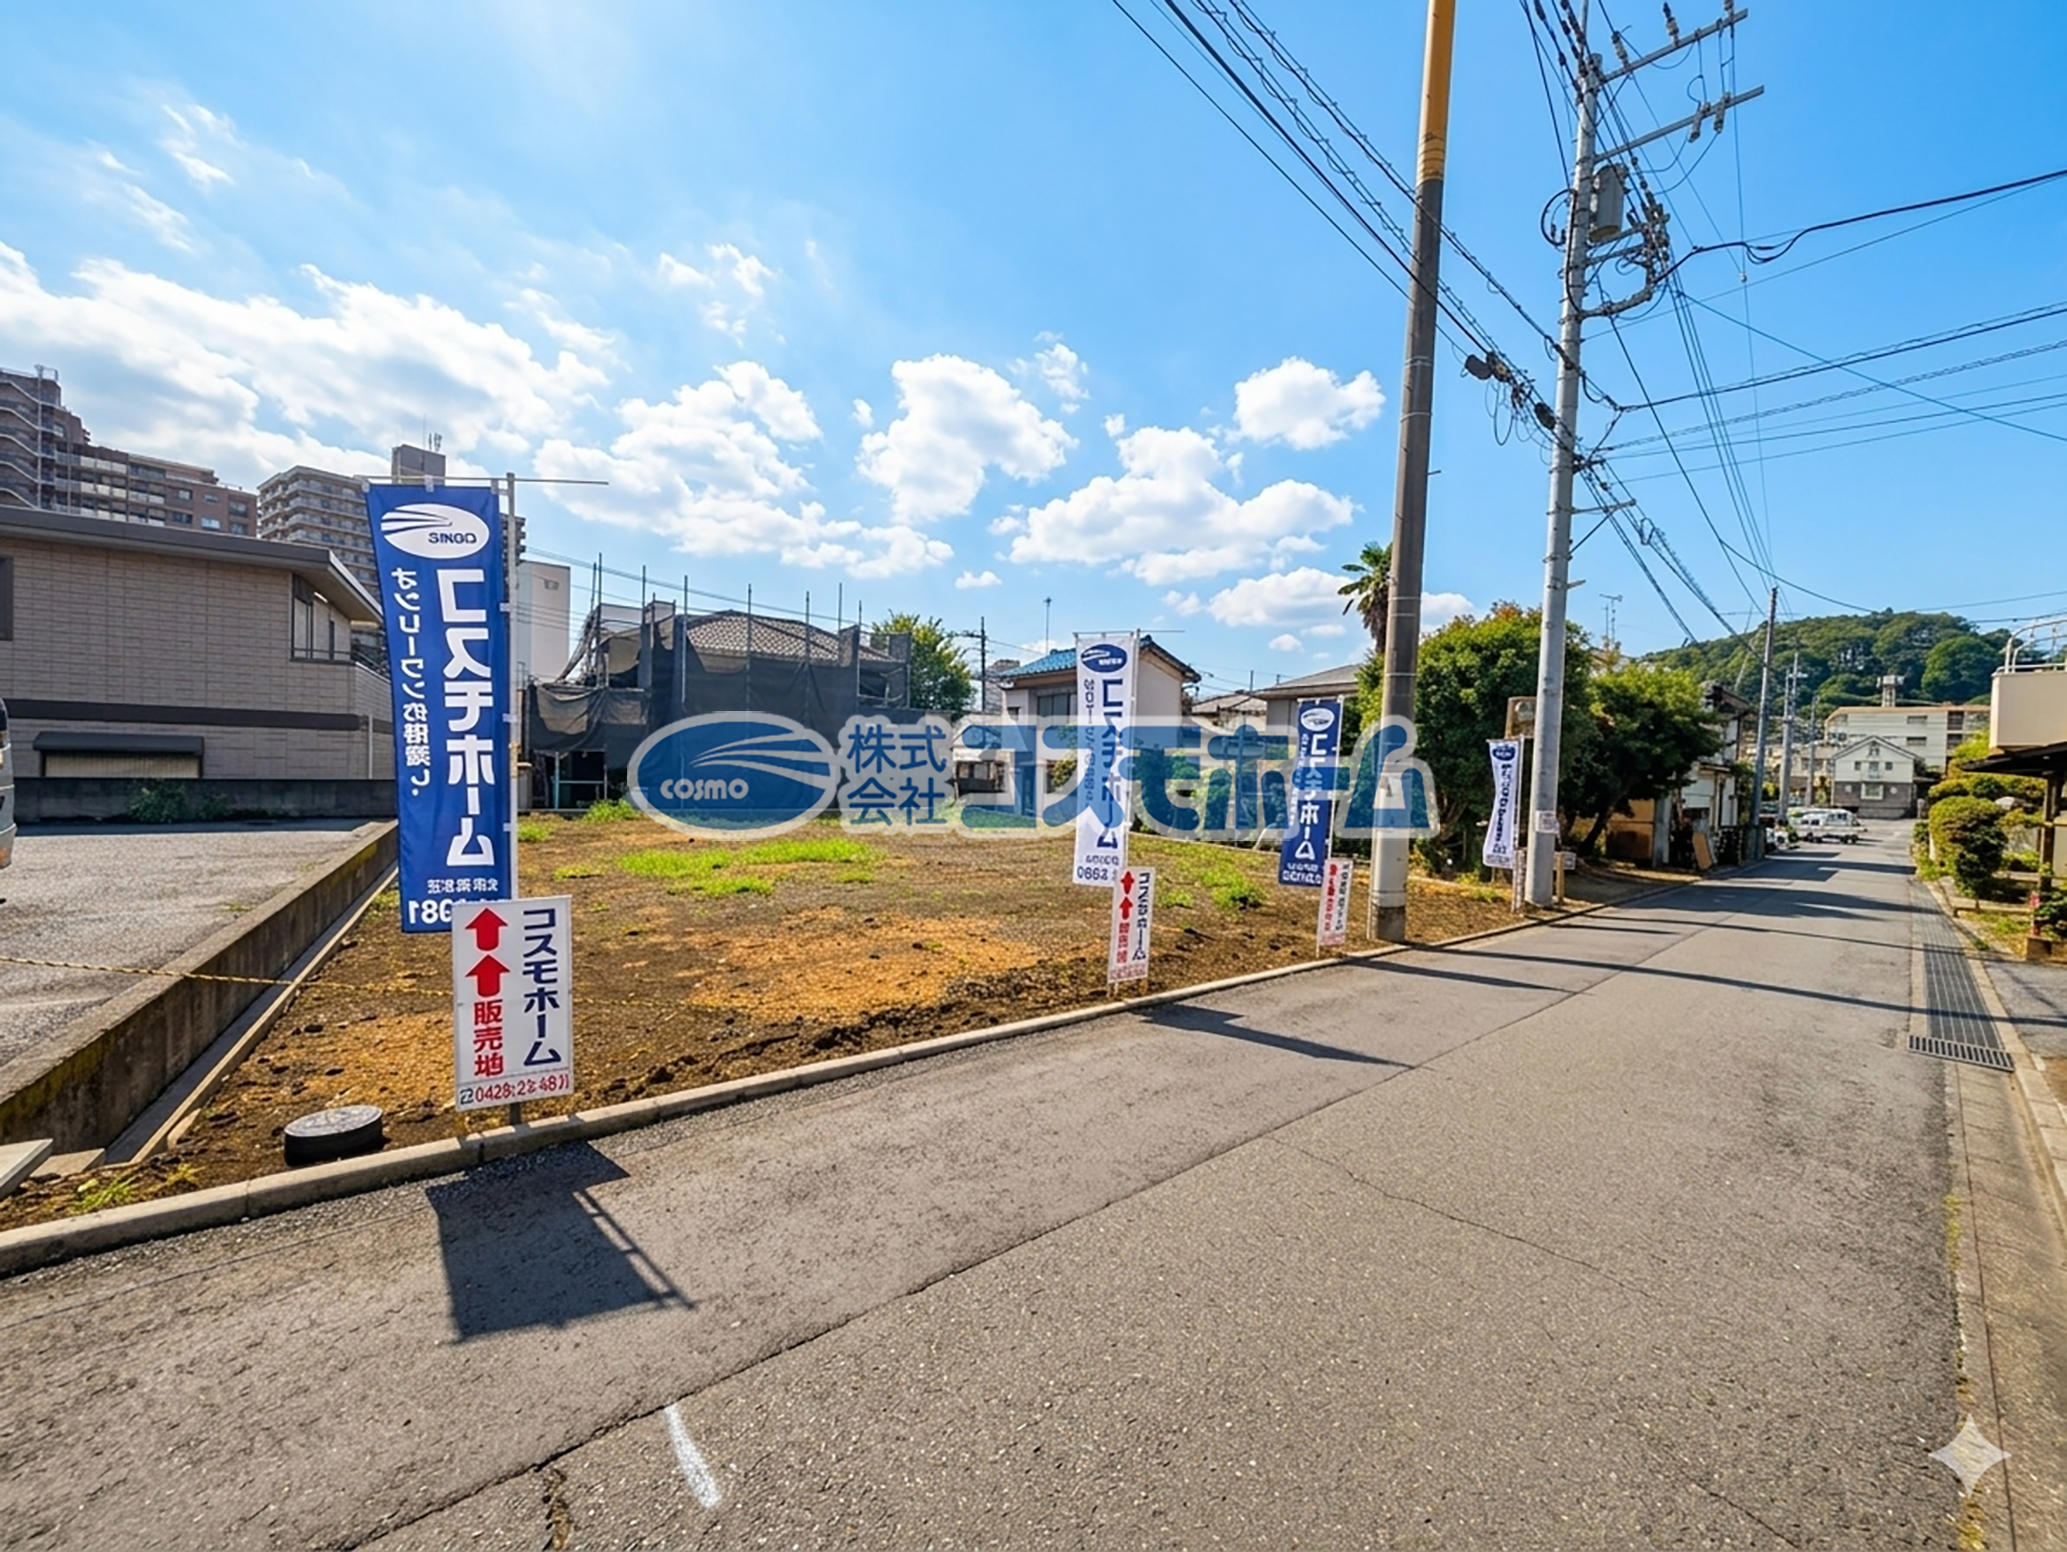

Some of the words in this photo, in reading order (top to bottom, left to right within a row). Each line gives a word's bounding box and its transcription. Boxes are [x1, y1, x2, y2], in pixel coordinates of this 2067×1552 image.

[473, 998, 505, 1078] 販売地
[523, 907, 562, 1067] コスモホーム
